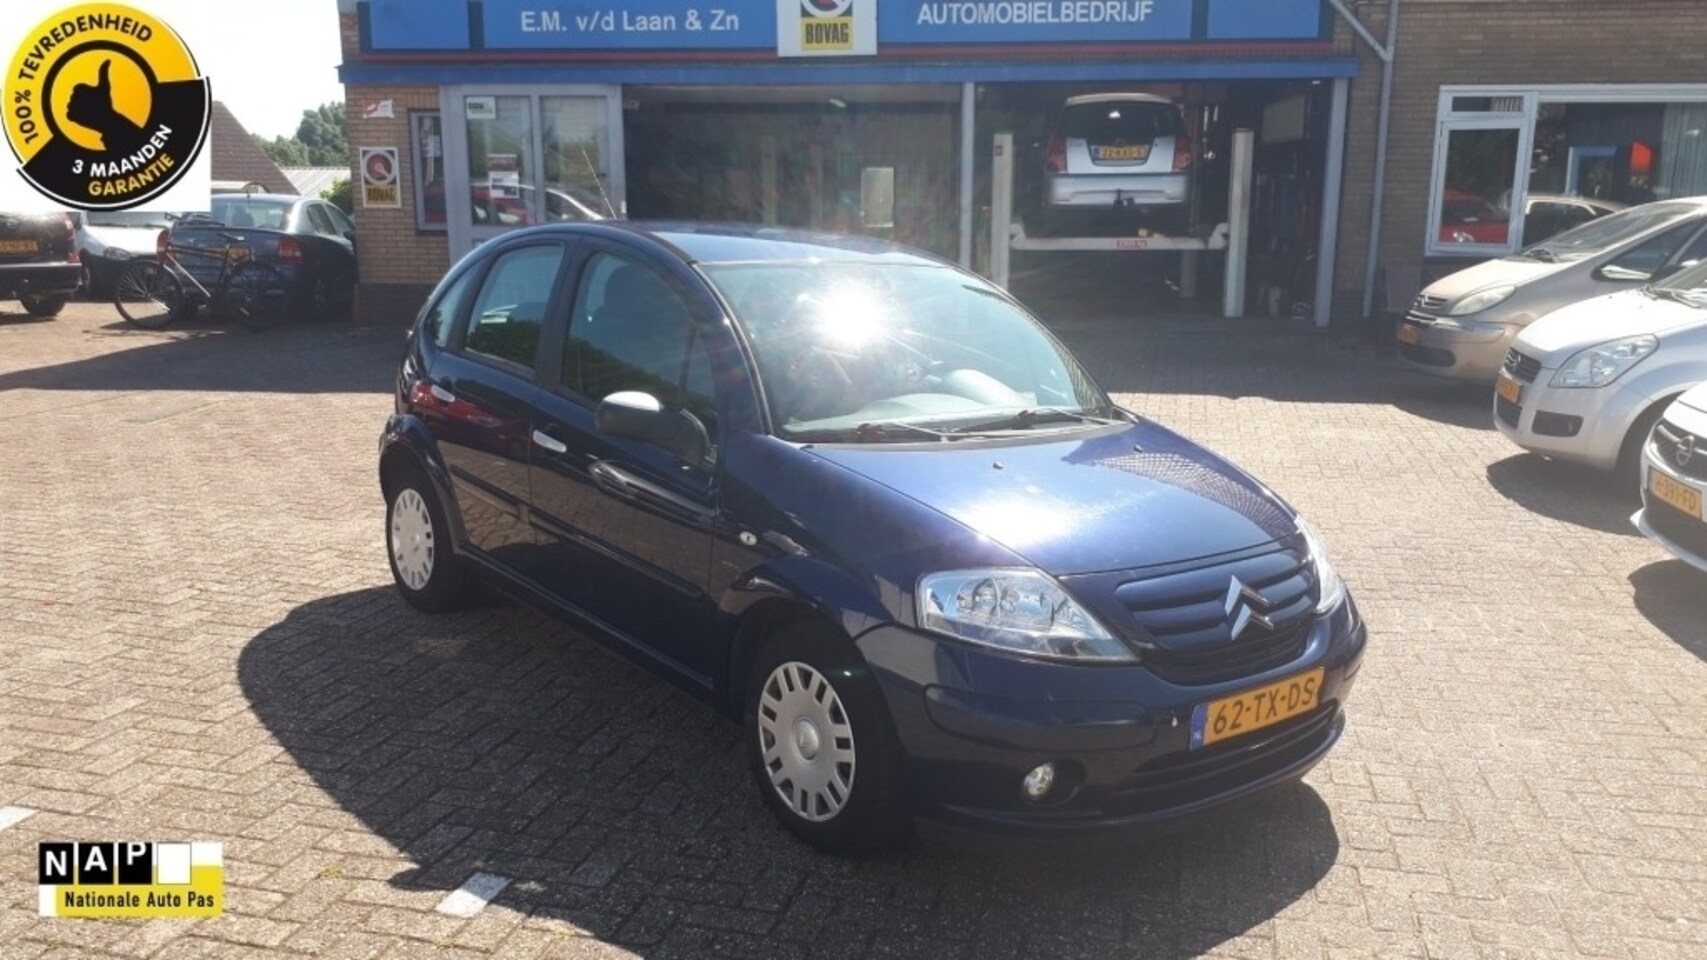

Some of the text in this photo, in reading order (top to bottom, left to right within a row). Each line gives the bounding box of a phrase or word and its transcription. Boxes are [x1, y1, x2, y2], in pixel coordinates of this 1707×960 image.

[520, 9, 740, 32] E.M. v/d Laan & Zn
[917, 1, 1154, 25] AUTOMOBIELBEDRIJF
[804, 22, 849, 44] BOVAG
[1213, 676, 1316, 735] 62-TX-DS
